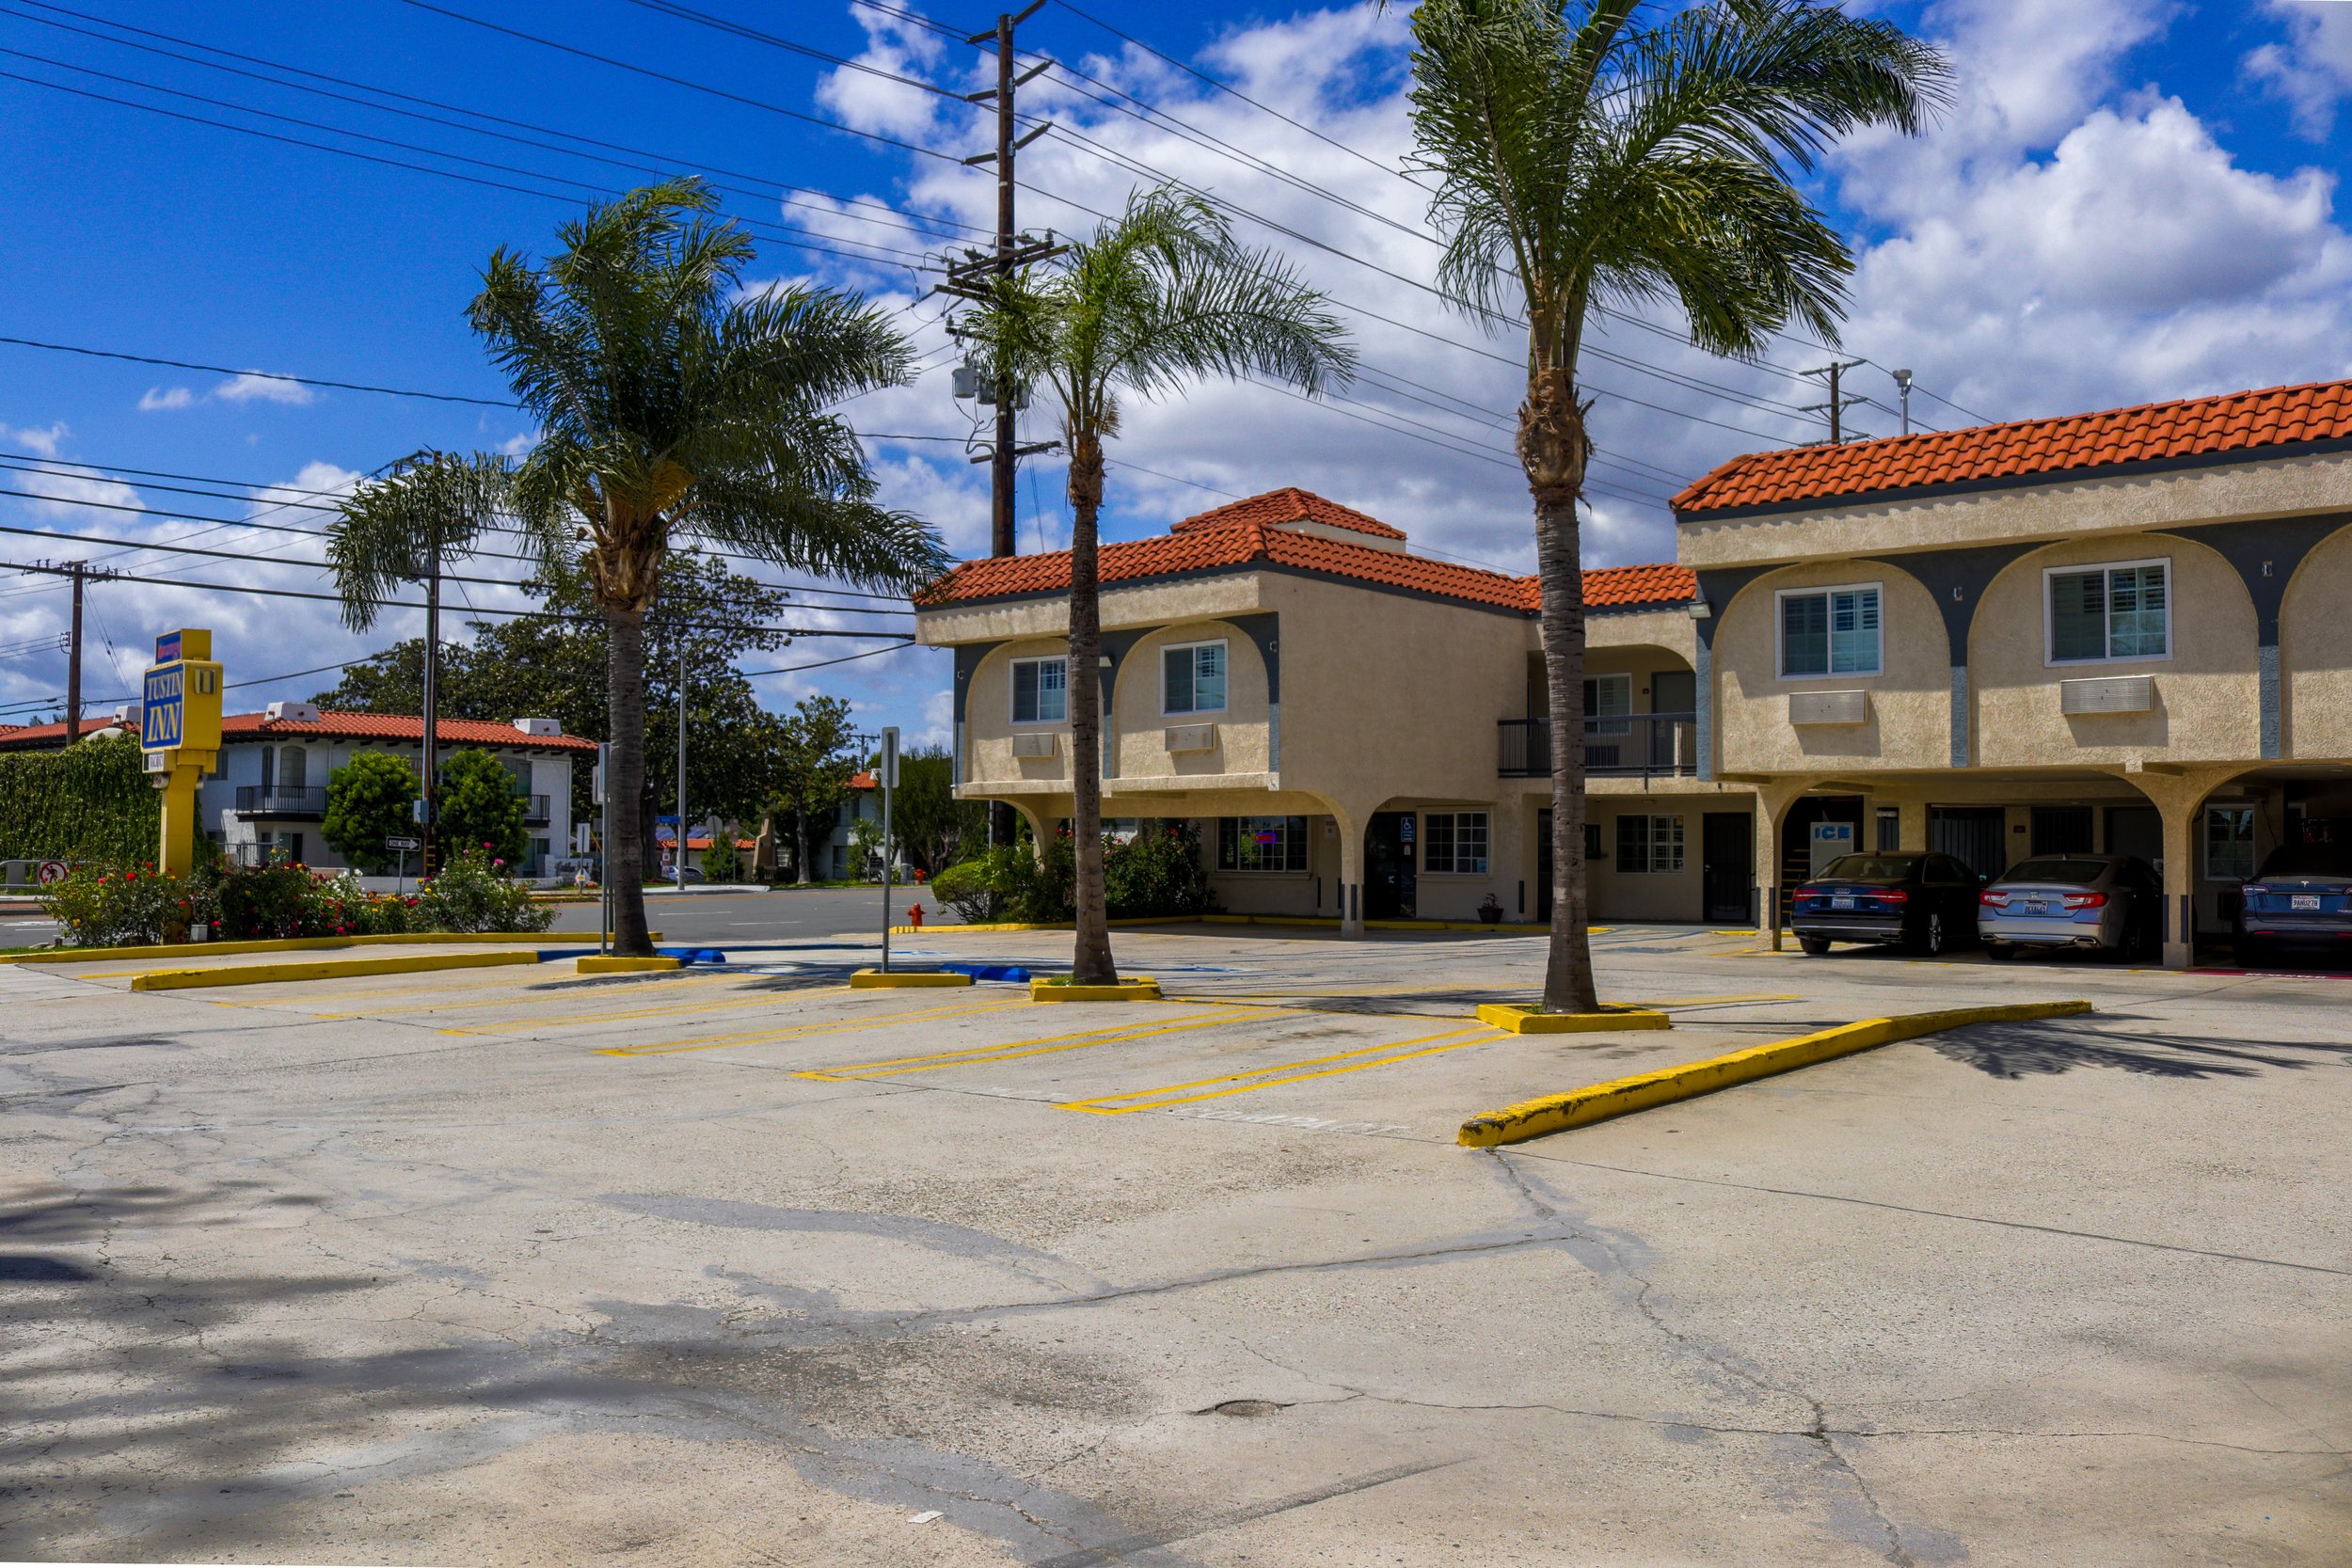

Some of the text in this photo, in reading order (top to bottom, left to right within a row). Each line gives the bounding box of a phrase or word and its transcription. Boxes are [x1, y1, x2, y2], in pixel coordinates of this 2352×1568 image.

[147, 671, 183, 702] TUSTIN
[147, 703, 182, 741] INN
[1814, 826, 1851, 839] ICE
